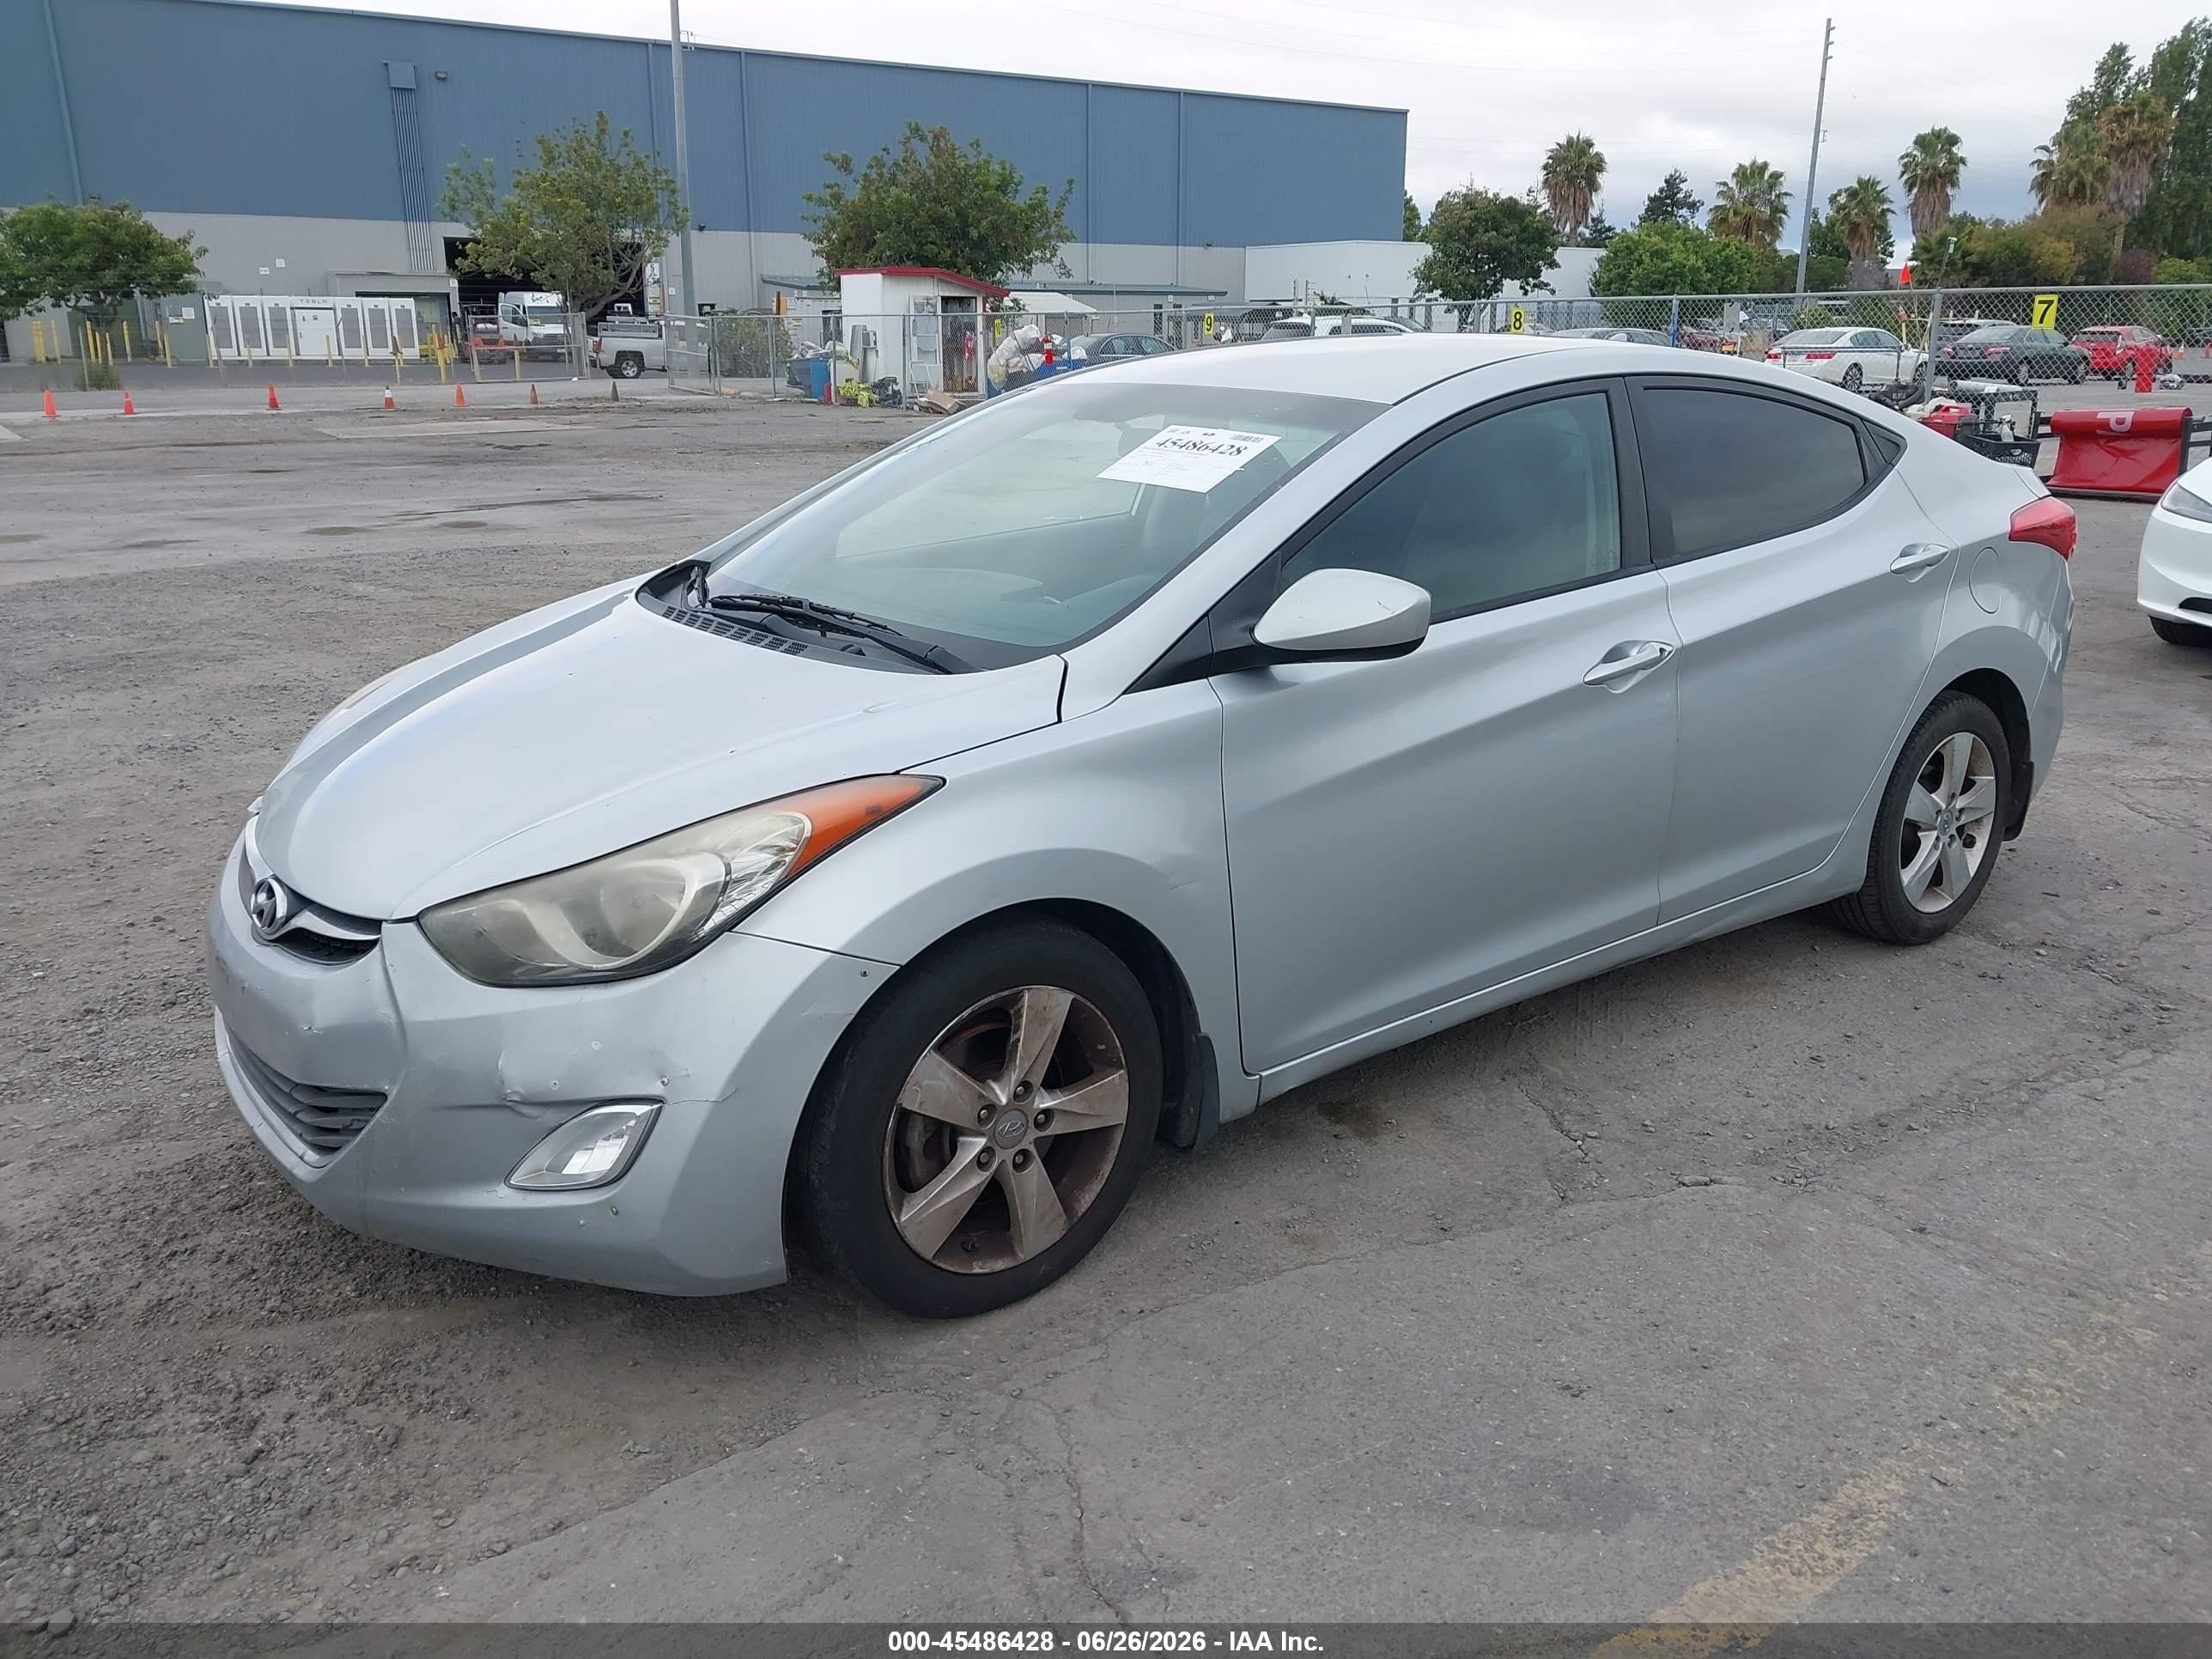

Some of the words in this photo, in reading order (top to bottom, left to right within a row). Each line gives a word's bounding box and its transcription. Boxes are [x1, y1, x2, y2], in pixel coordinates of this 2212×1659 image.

[1513, 311, 1522, 331] 8
[2038, 300, 2055, 325] 7
[1206, 315, 1212, 332] 9
[2096, 411, 2136, 435] P
[1156, 437, 1248, 457] 45486428
